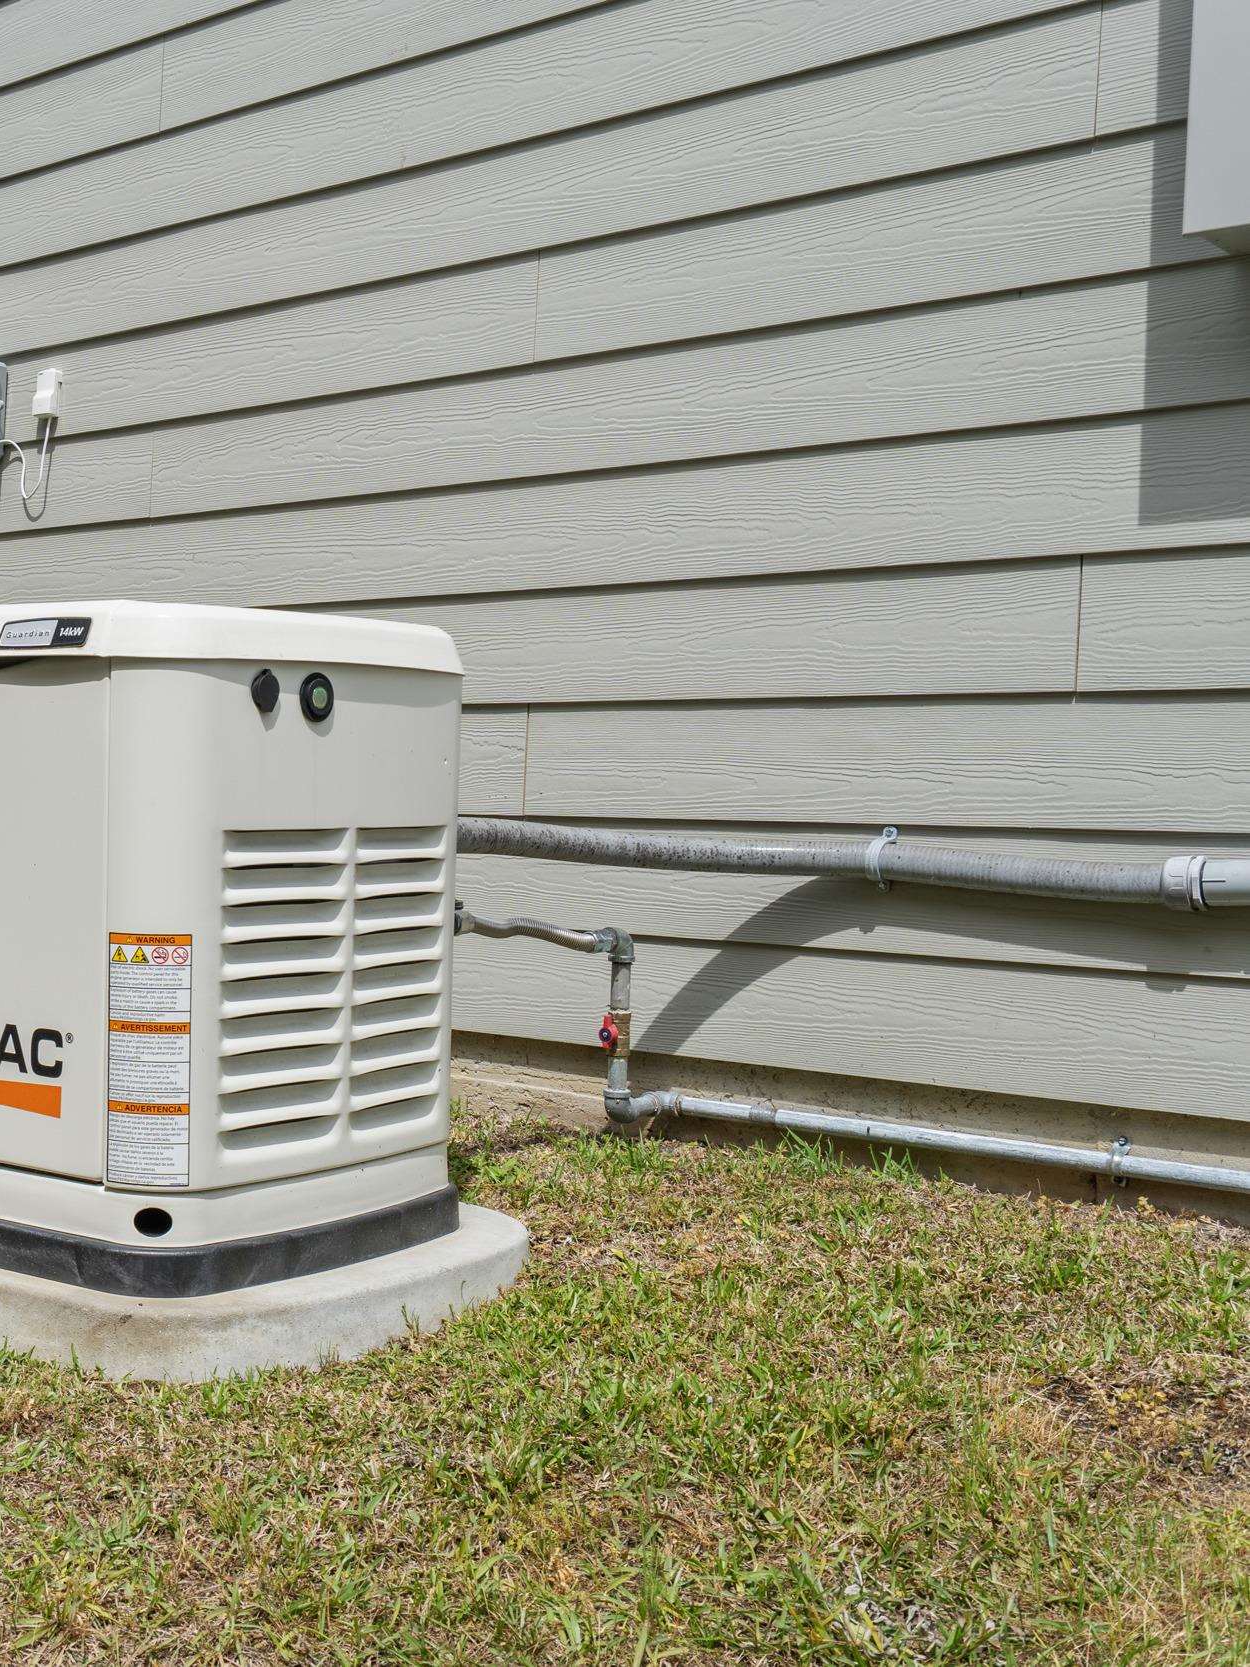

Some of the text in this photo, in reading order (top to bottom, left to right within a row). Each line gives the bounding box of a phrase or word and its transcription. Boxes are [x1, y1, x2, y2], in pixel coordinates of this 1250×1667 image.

[6, 626, 84, 639] Guardian 14kW
[135, 936, 176, 944] WARNING
[120, 1023, 188, 1032] AVERTISSEMENT
[124, 1104, 183, 1113] ADVERTENCIA
